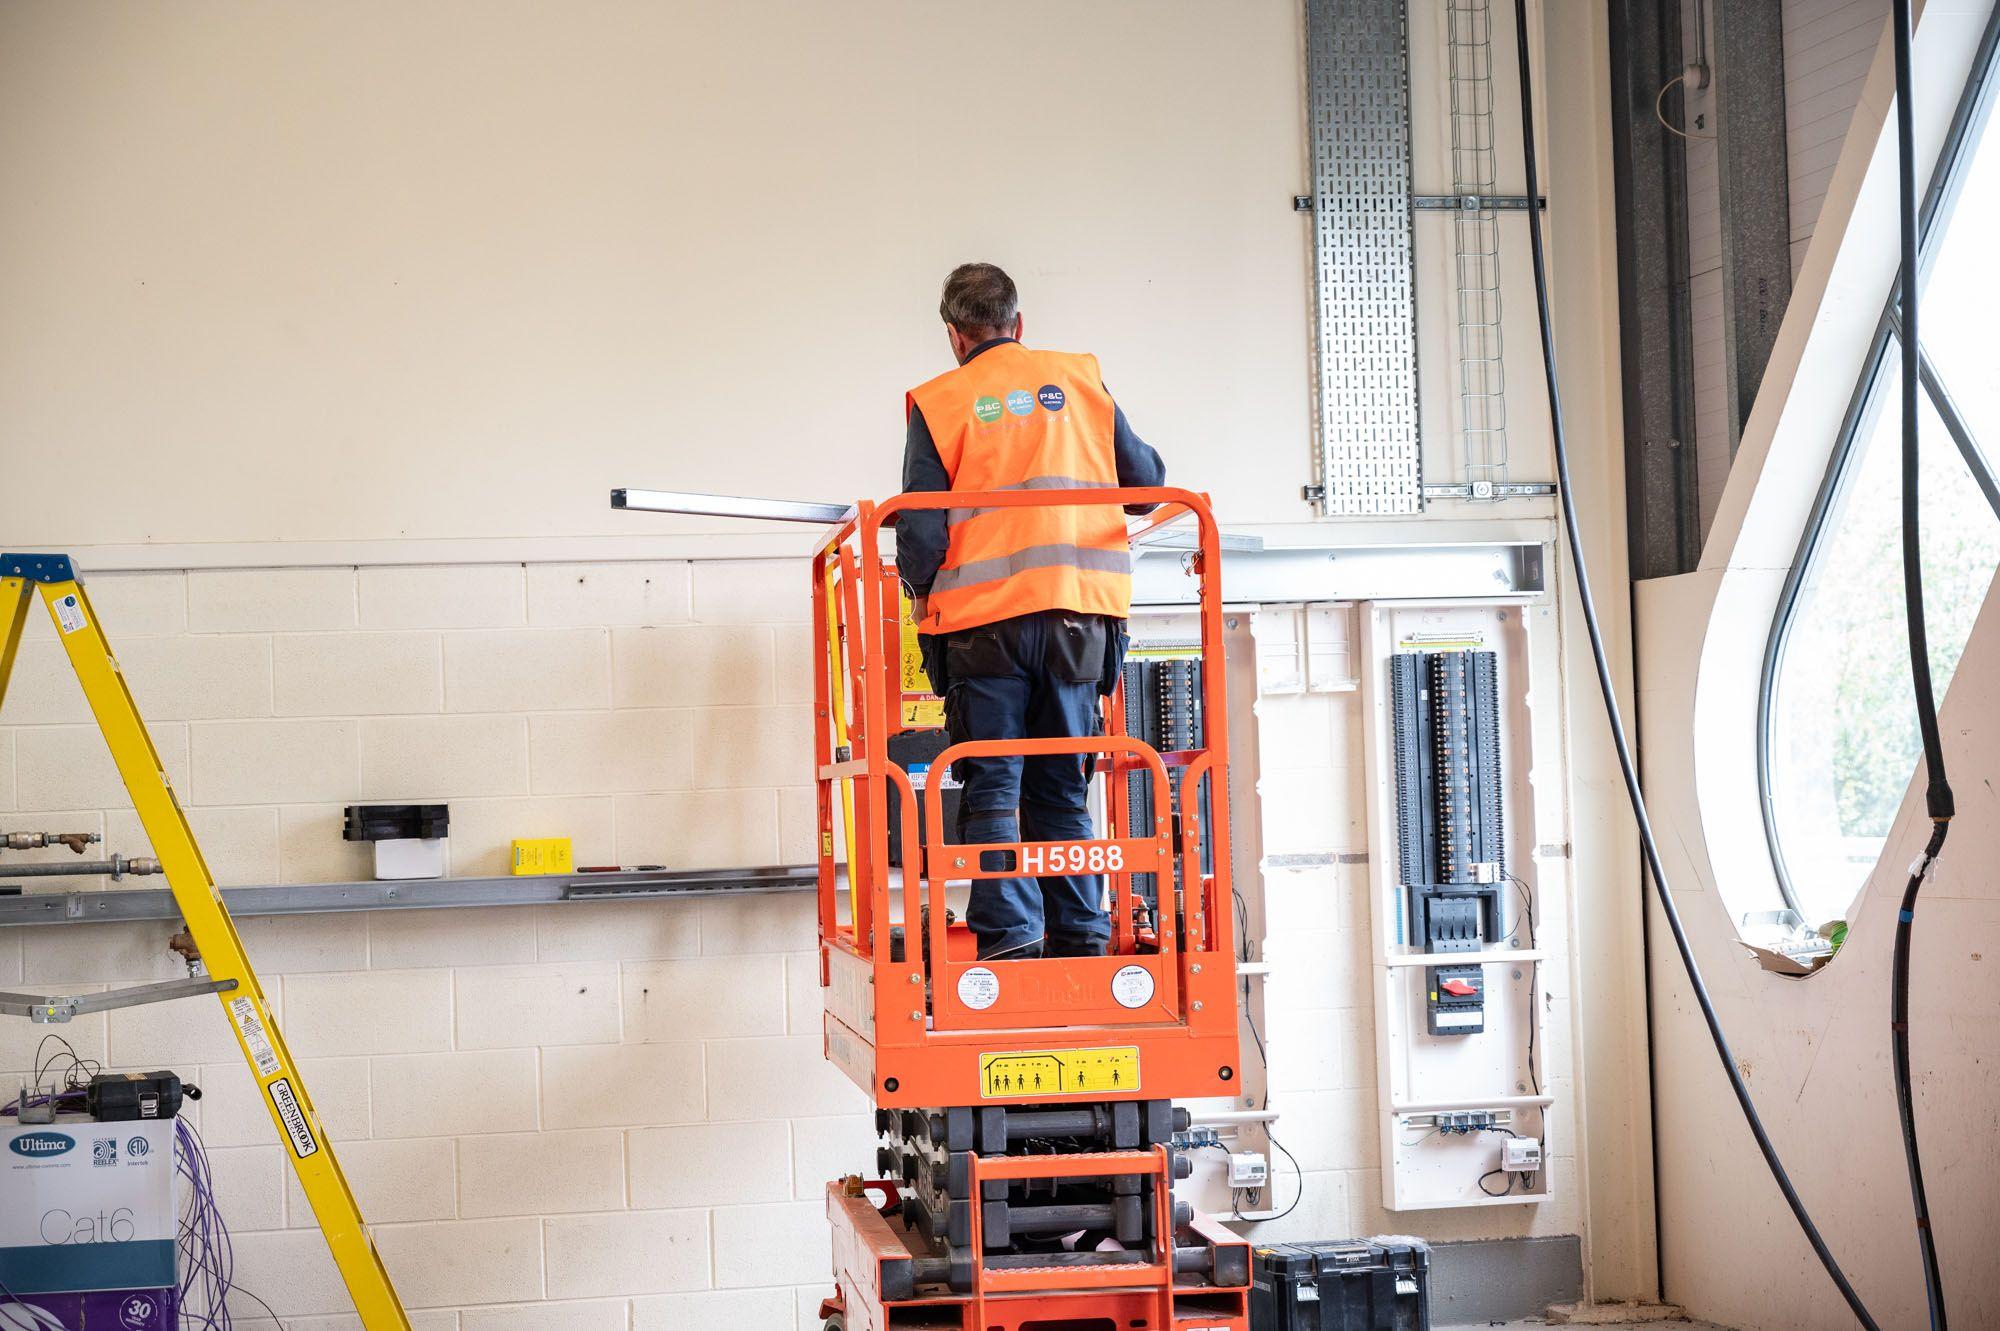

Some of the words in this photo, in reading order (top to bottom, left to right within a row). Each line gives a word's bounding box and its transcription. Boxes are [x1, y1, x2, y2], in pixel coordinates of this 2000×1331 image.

[1008, 396, 1032, 406] P&C
[1039, 392, 1063, 400] P&C
[976, 402, 1000, 413] P&C
[1022, 845, 1124, 873] H5988
[276, 1083, 313, 1152] GREENBROOK
[279, 1101, 298, 1138] ELECTRICAL
[19, 1138, 66, 1151] Ultima
[41, 1207, 134, 1245] Cat6
[128, 1299, 152, 1318] 30
